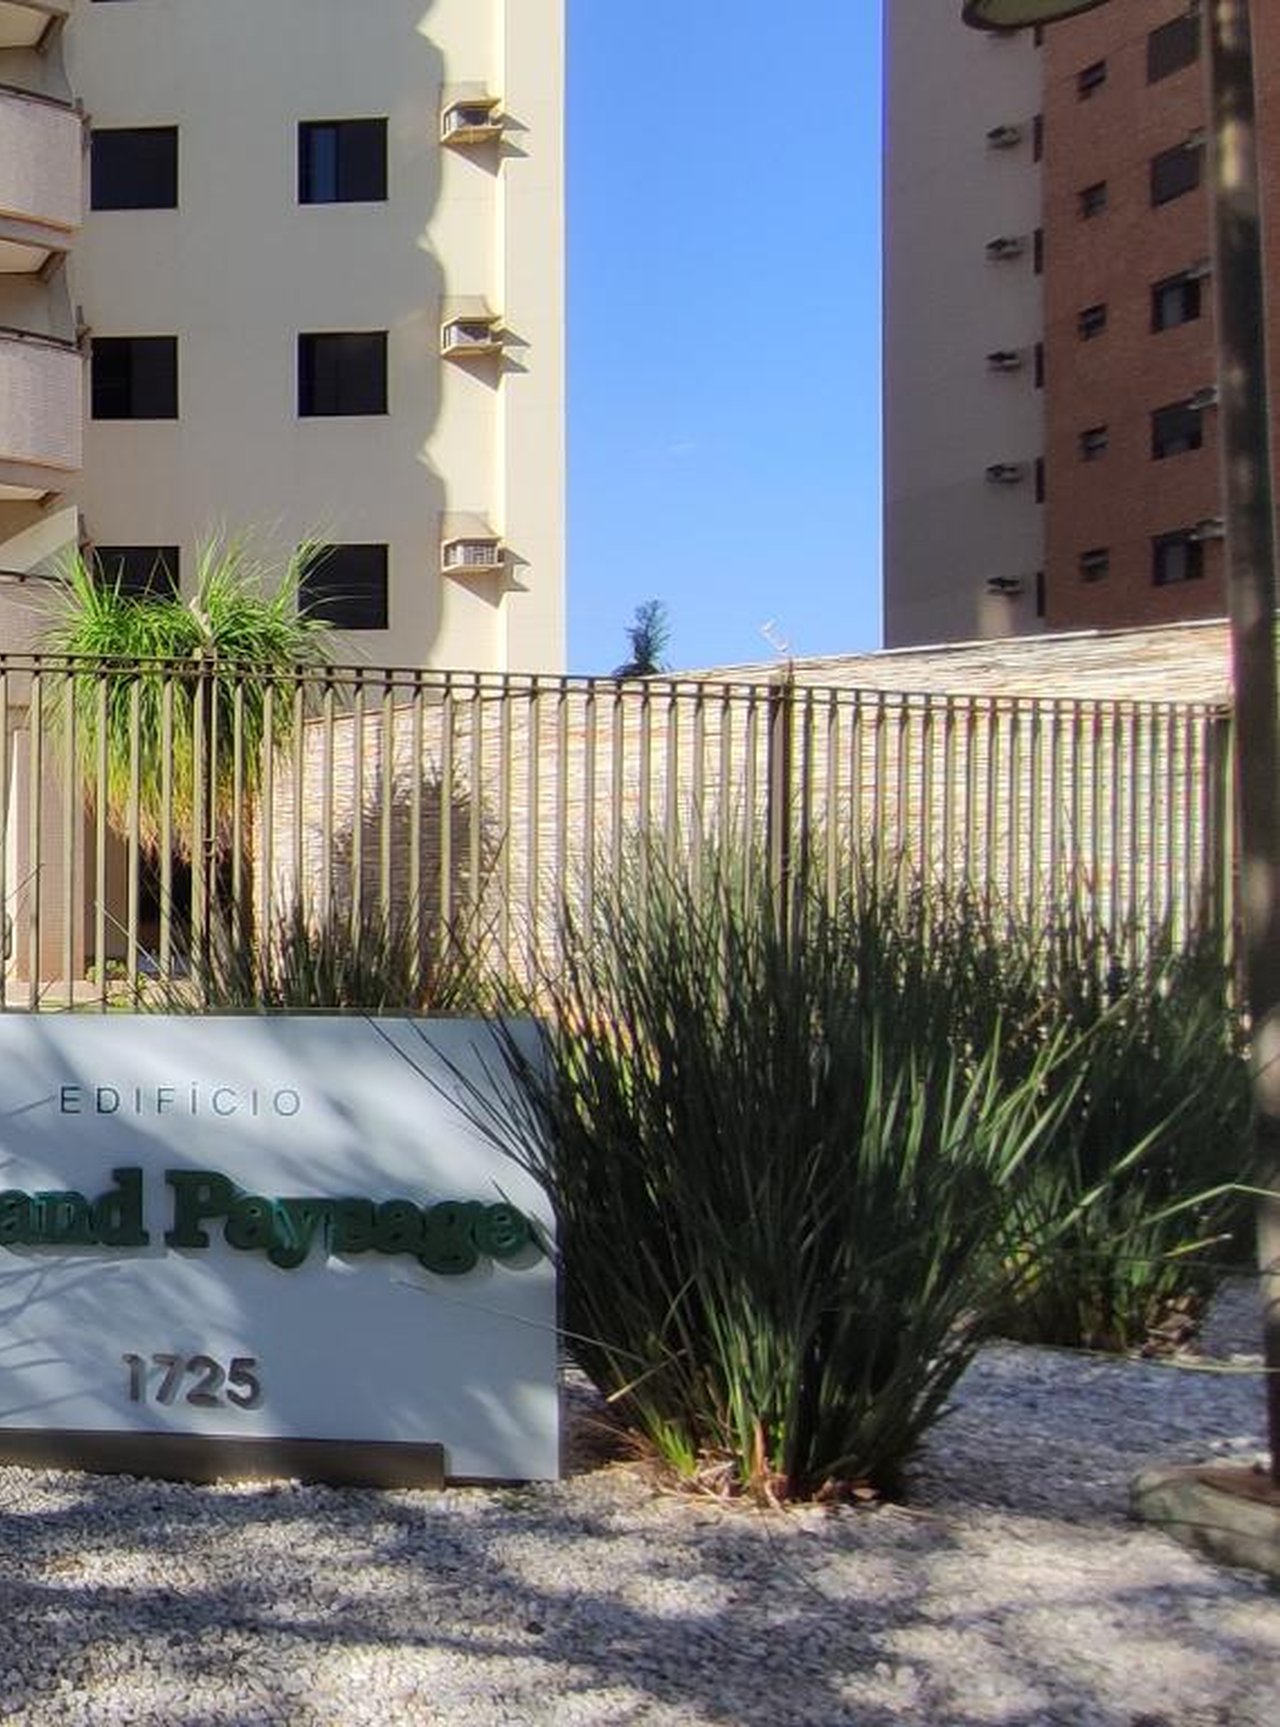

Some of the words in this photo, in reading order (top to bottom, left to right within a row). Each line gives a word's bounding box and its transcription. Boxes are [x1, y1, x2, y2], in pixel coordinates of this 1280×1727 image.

[60, 1081, 301, 1116] EDIFÍCIO
[165, 1169, 531, 1275] Paysage
[121, 1353, 261, 1409] 1725
